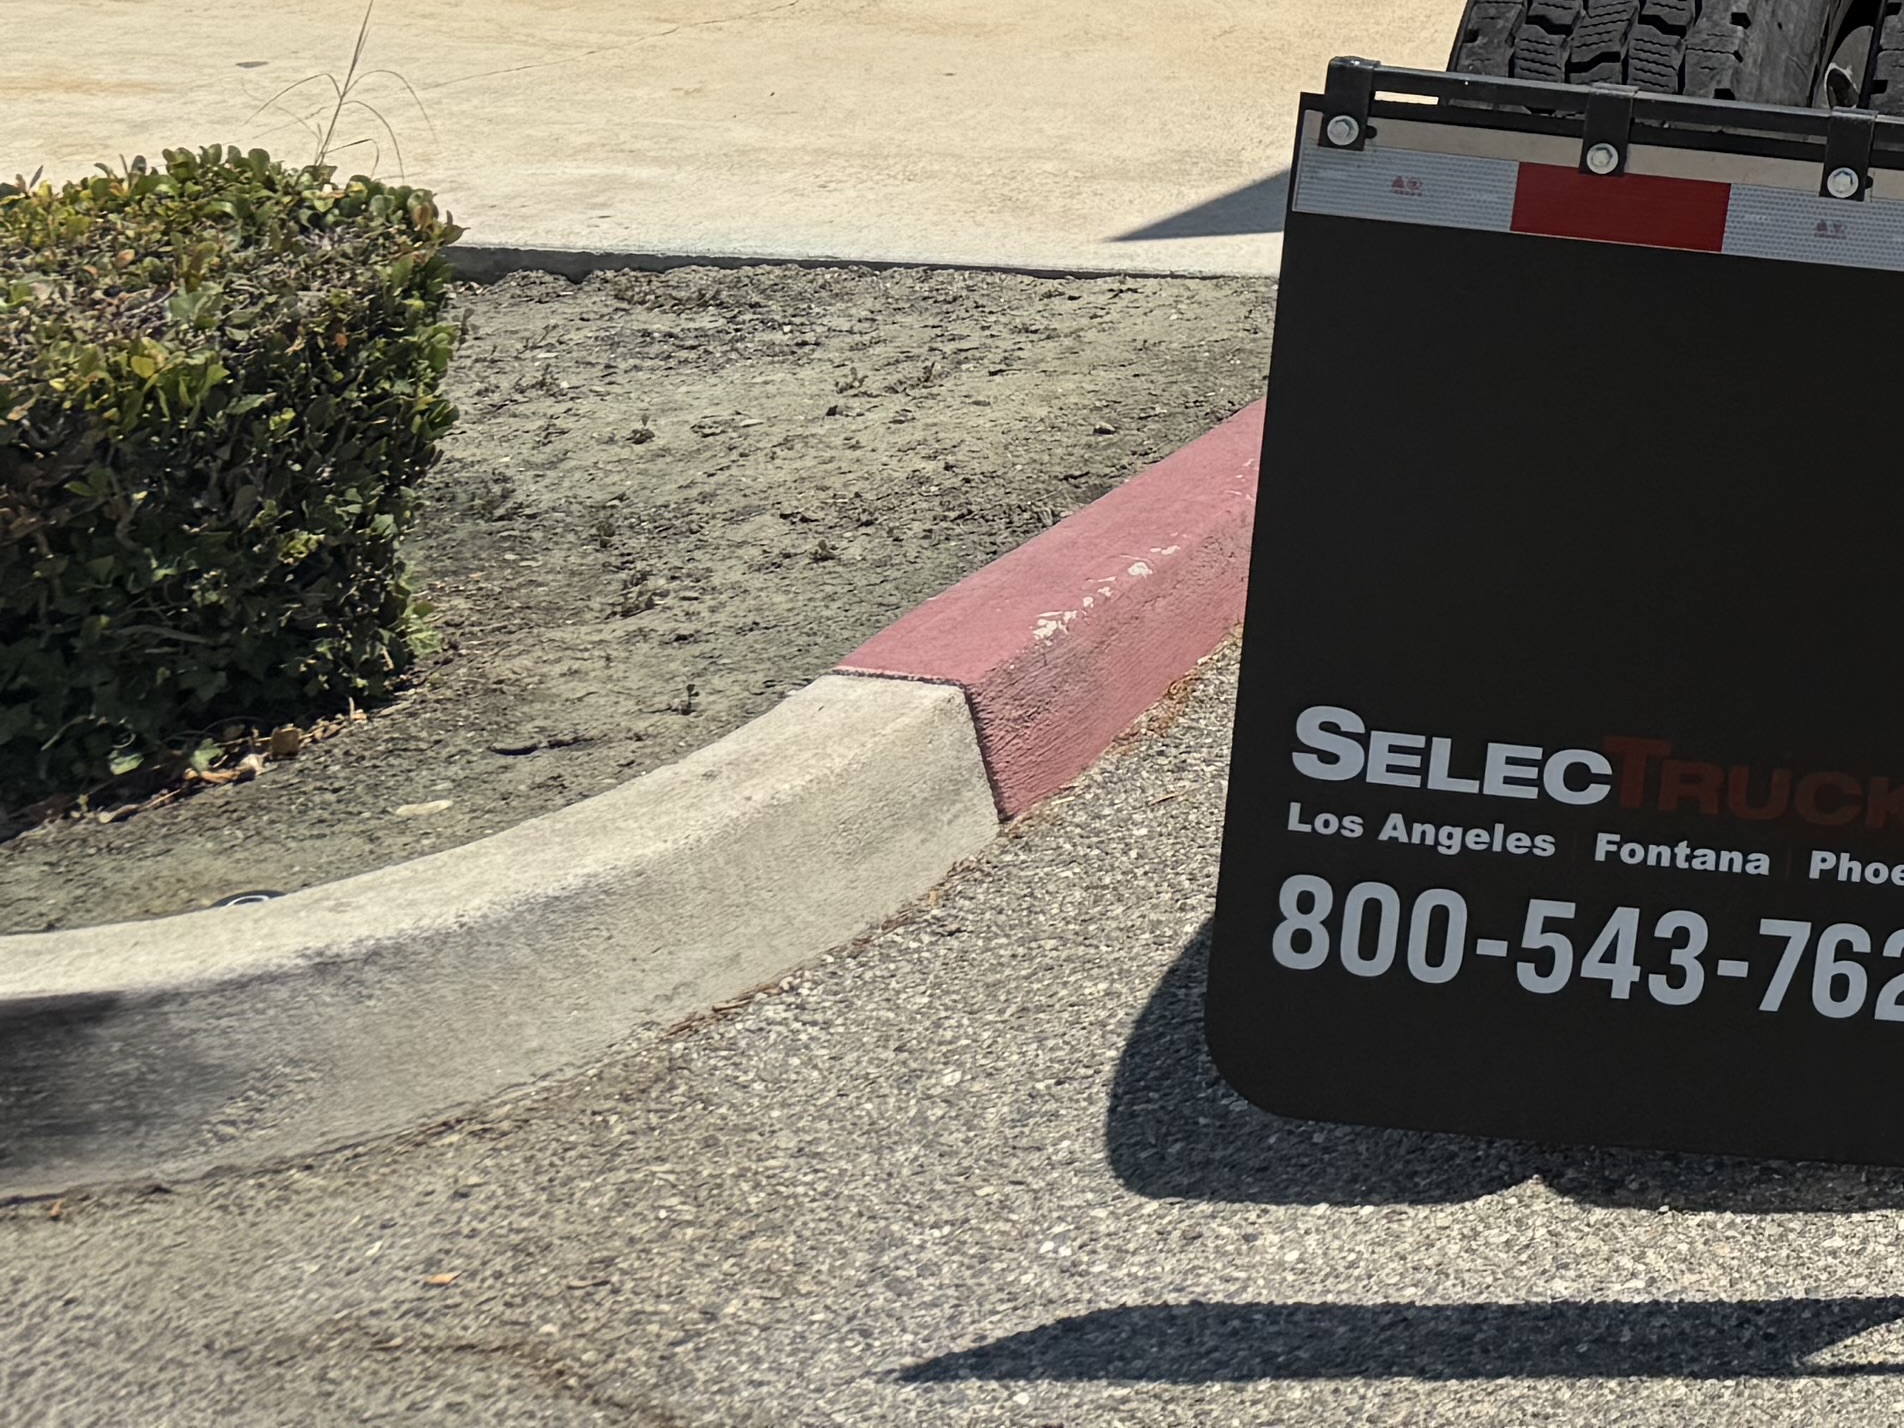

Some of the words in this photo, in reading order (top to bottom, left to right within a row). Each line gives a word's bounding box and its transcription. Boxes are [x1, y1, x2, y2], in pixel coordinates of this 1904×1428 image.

[1287, 803, 1364, 840] Los
[1379, 812, 1557, 857] Angeles
[1594, 832, 1772, 876] Fontana
